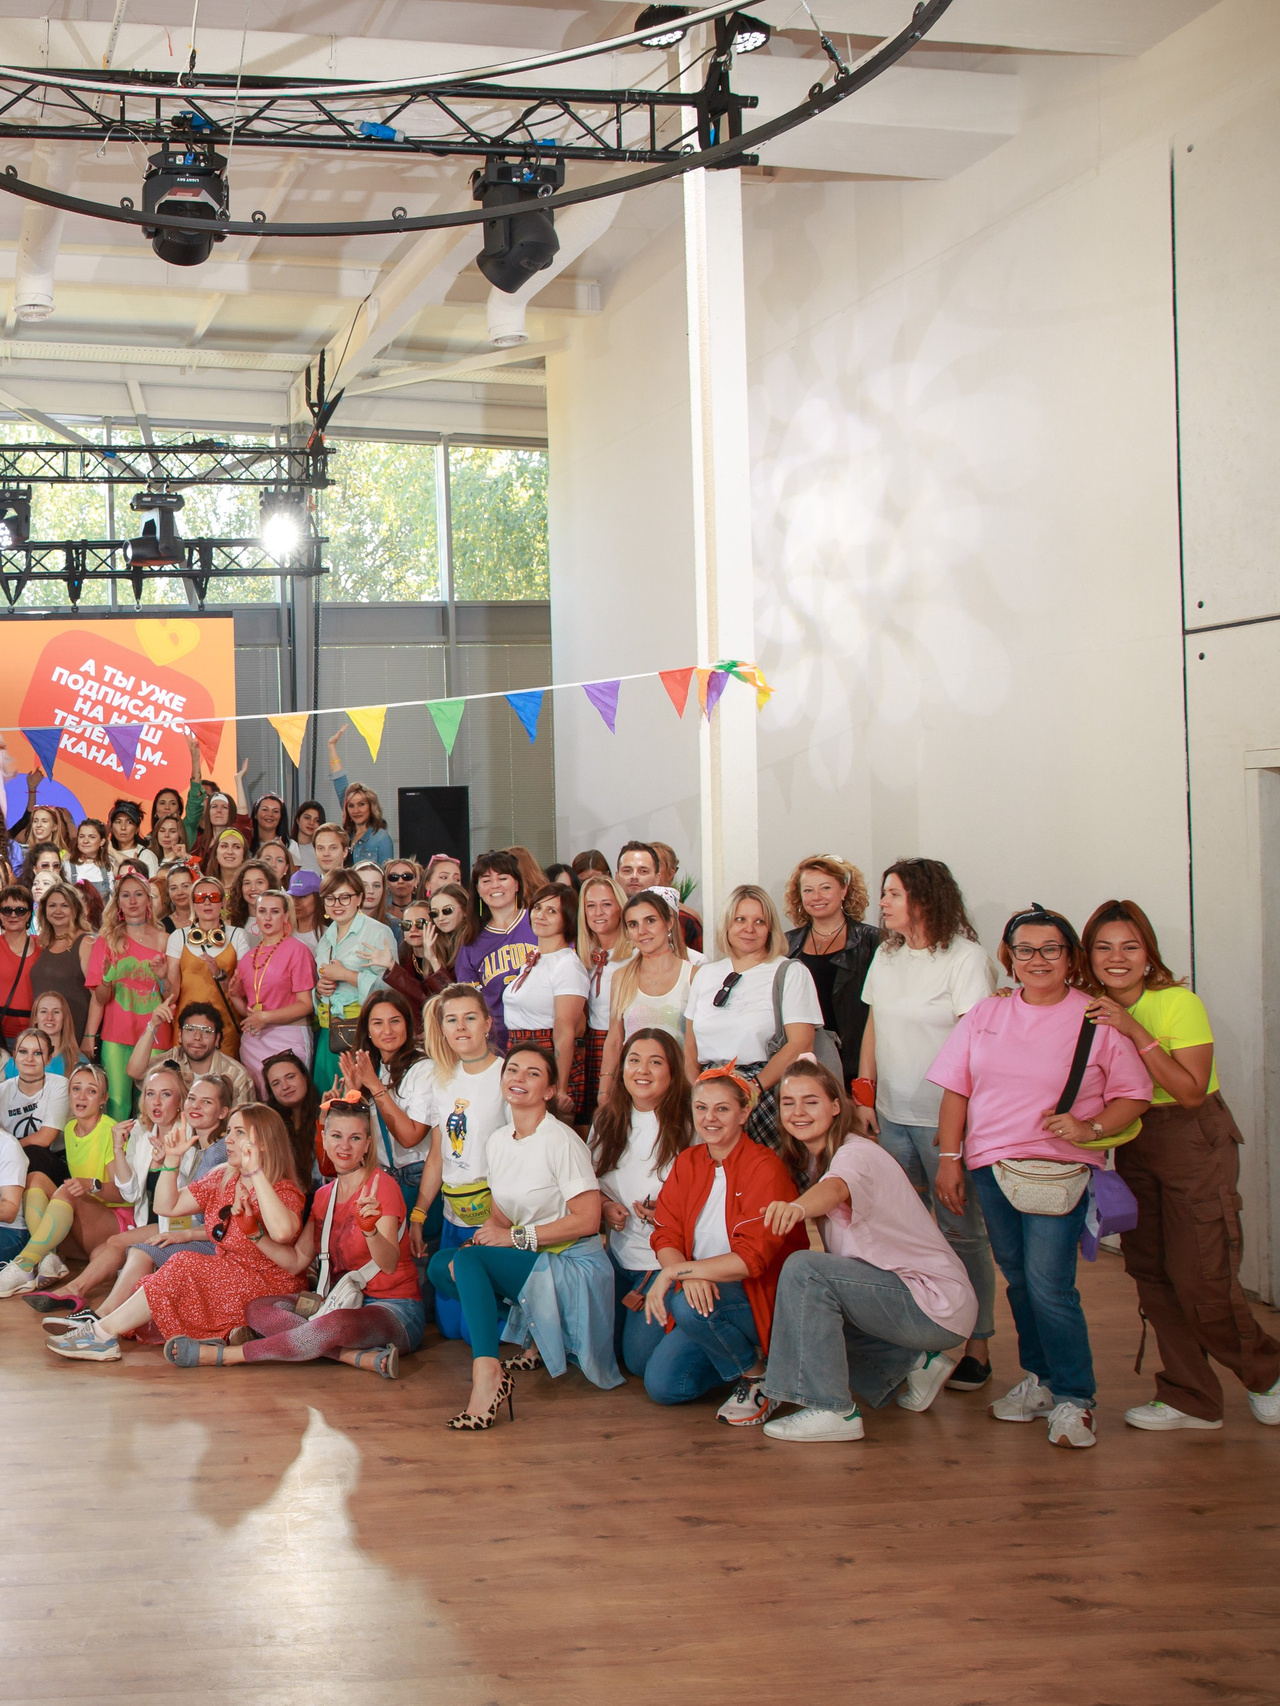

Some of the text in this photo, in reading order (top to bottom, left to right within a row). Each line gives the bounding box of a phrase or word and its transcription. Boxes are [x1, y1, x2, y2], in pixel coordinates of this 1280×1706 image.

[79, 658, 187, 712] А ТЫ УЖЕ
[53, 708, 169, 766] ТЕЛЕМ-
[73, 697, 163, 745] НА НШ
